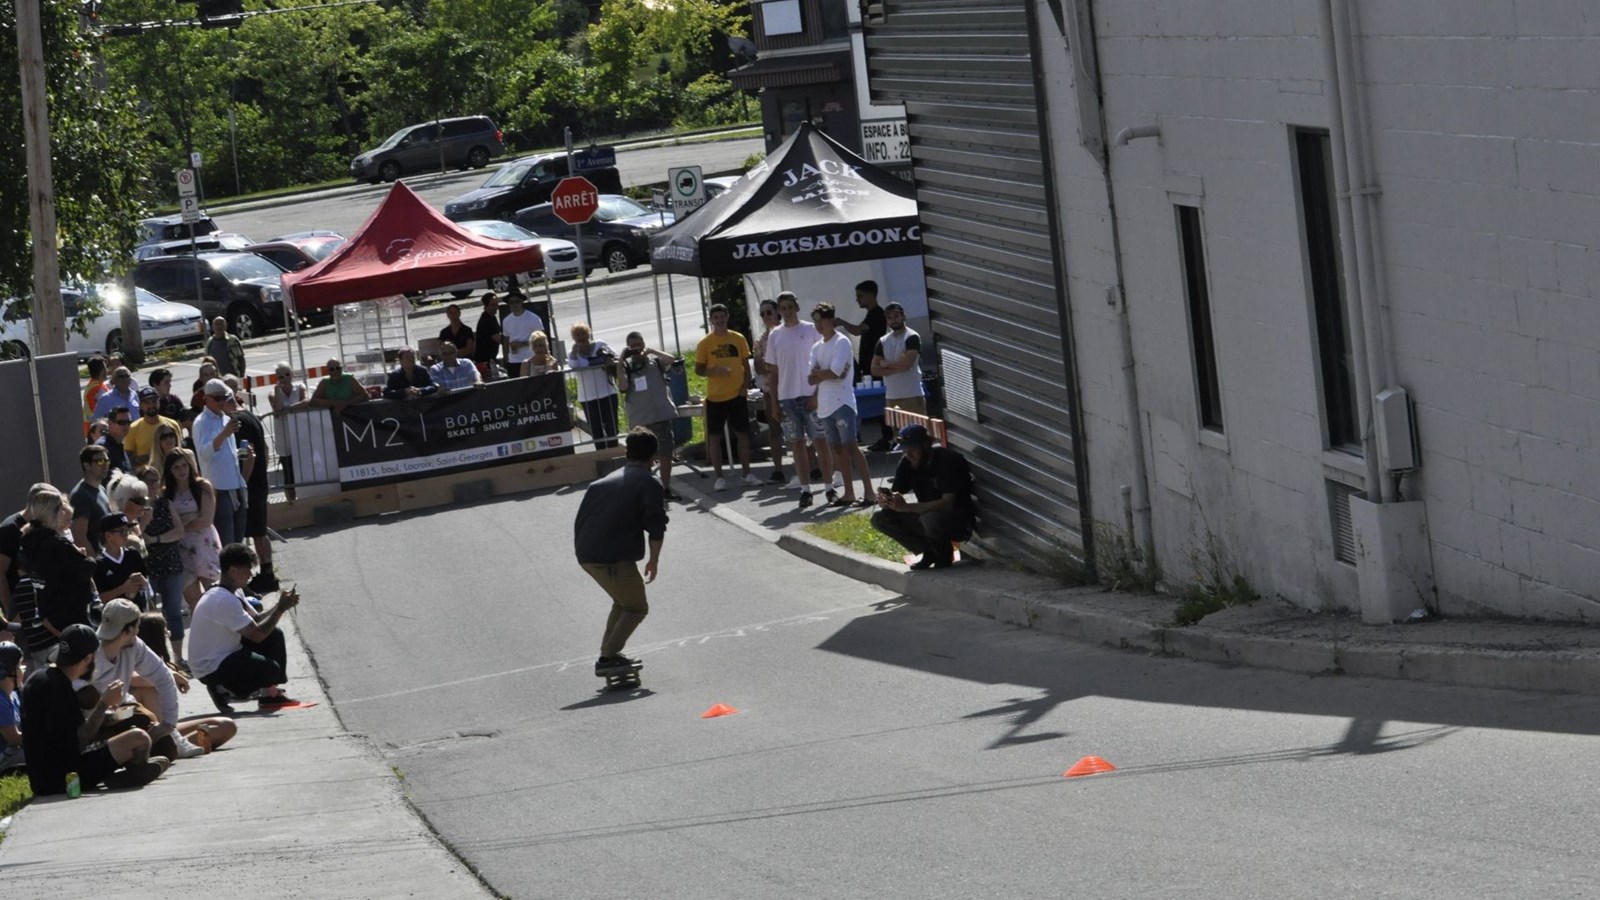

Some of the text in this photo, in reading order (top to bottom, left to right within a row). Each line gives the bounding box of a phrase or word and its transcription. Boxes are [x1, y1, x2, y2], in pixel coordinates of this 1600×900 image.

[863, 124, 892, 139] ESPACE
[865, 141, 891, 161] INFO.
[586, 156, 615, 168] Avenue
[782, 159, 862, 187] JACK
[555, 190, 595, 210] ARRÊT
[674, 198, 704, 210] TRANSIT
[342, 417, 404, 453] M2
[447, 412, 558, 439] SKATE SNOW APPAREL
[436, 449, 493, 466] Saint-Georges
